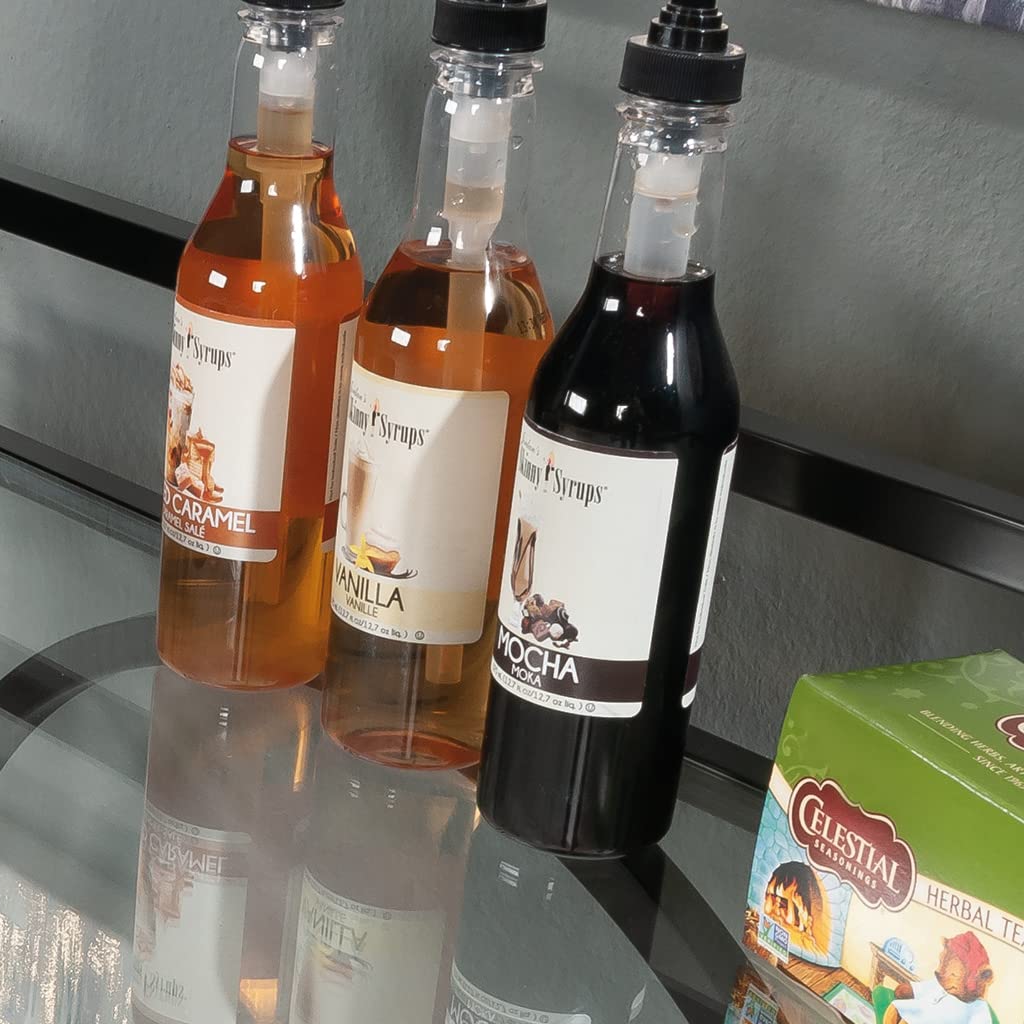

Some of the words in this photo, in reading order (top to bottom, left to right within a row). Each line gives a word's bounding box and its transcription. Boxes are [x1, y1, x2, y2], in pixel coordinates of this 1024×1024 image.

[193, 336, 232, 371] Syrups
[379, 413, 424, 449] Syrups
[553, 468, 602, 507] Syrups
[172, 493, 256, 534] CARAMEL
[335, 560, 404, 612] VANILLA
[346, 594, 378, 618] VANILLE
[497, 624, 579, 684] MOCHA
[511, 663, 542, 688] MOKA
[920, 709, 973, 741] BLENDING
[973, 755, 1007, 775] SINCE
[798, 794, 901, 894] CELESTIAL
[813, 839, 877, 889] SEASONINGS
[927, 885, 993, 932] HERBAL
[1002, 916, 1024, 947] TE
